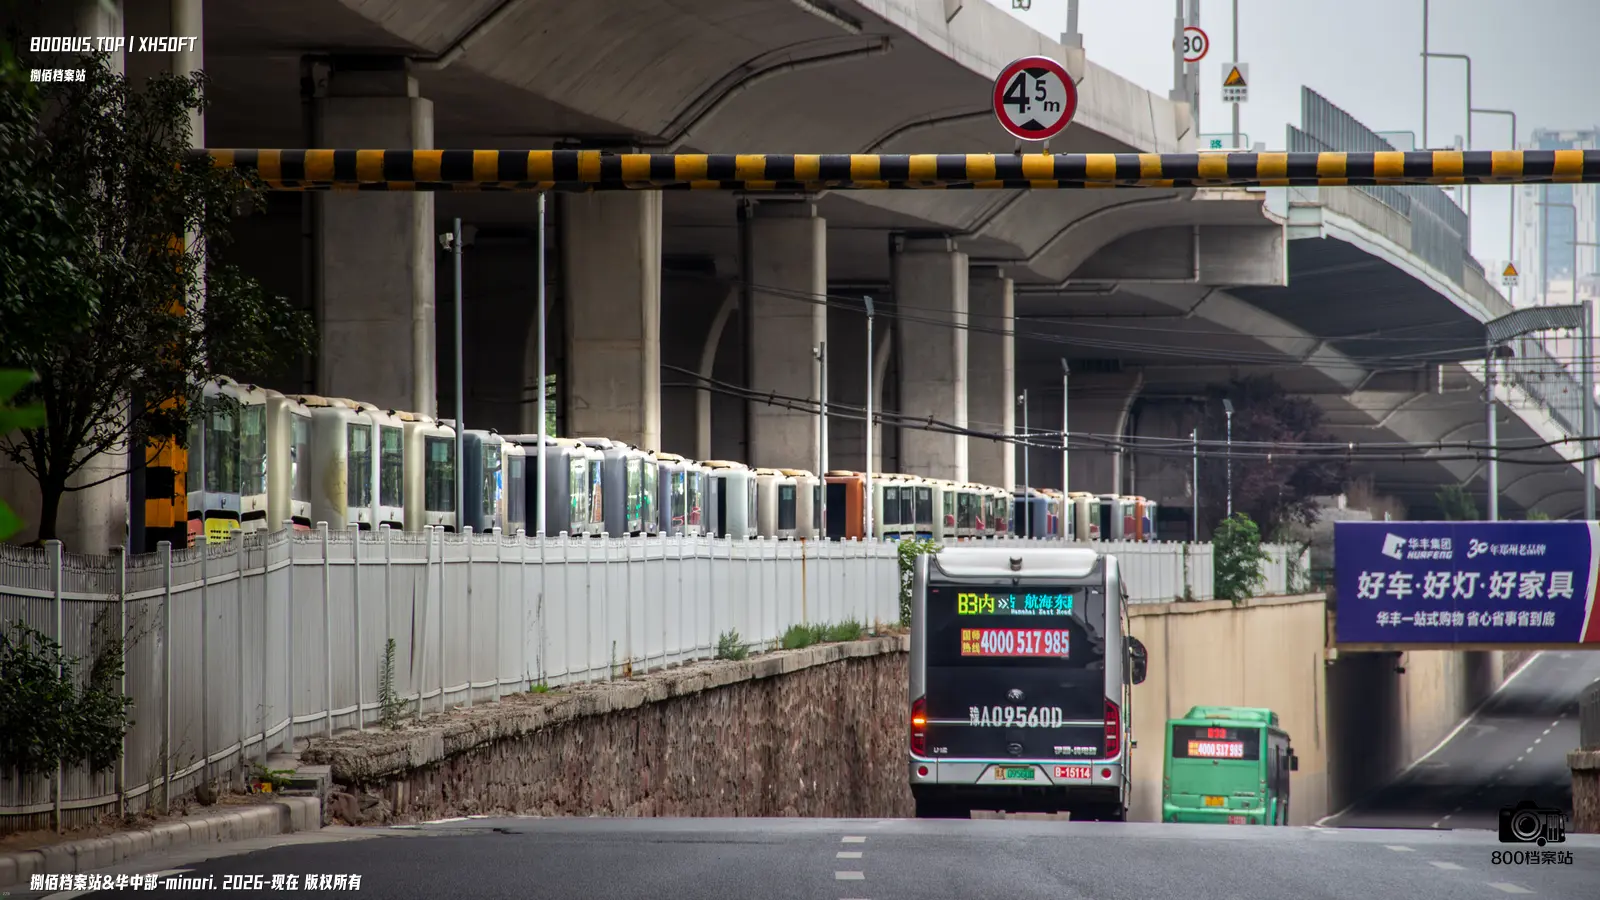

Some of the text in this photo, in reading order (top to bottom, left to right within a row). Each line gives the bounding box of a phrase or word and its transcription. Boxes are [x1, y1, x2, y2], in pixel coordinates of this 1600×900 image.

[1408, 537, 1452, 550] 华丰集团
[1357, 571, 1574, 600] 好车·好灯·好家具
[958, 593, 995, 615] B3内
[1376, 611, 1555, 627] 华丰一站式购物 省心省事省到底
[981, 630, 1070, 654] 4000 517 985
[969, 706, 1063, 728] 豫A09560D
[1054, 767, 1090, 779] B-15114
